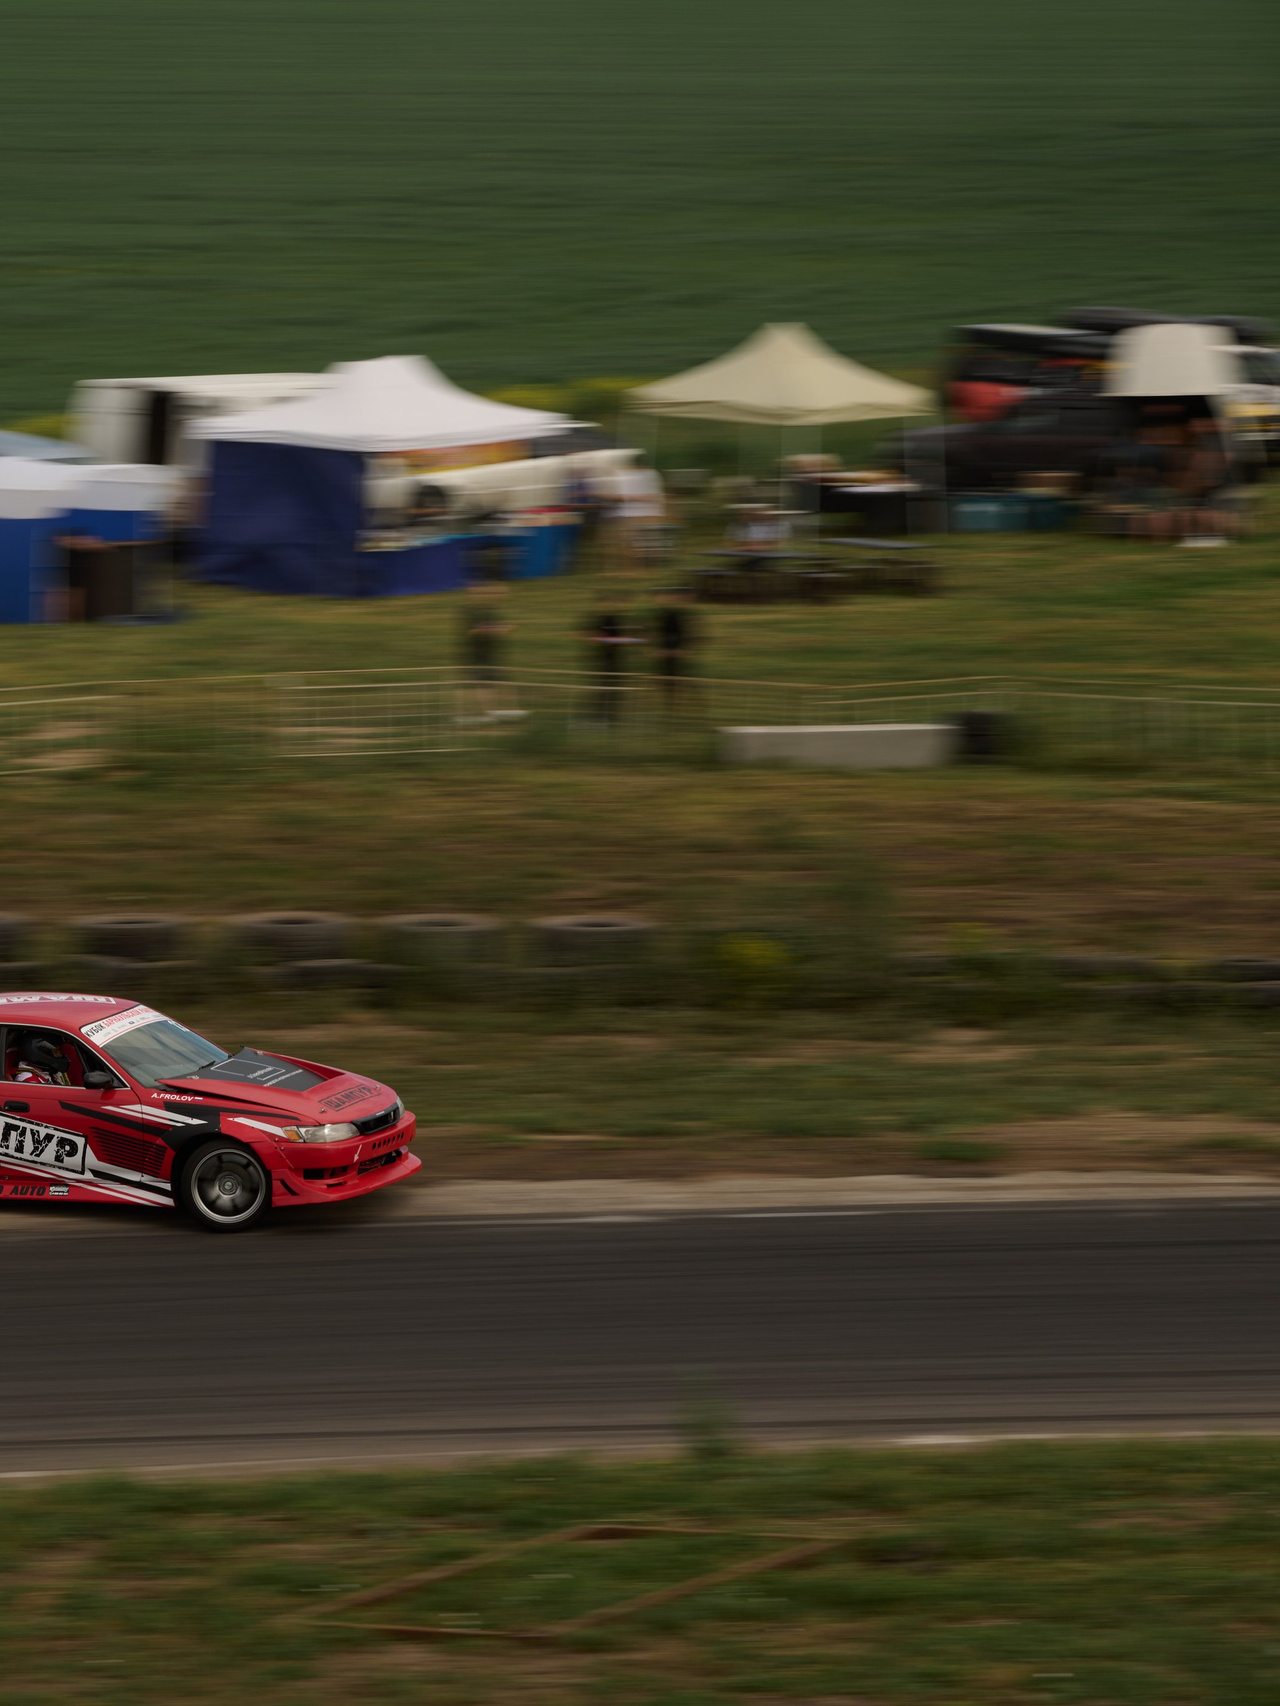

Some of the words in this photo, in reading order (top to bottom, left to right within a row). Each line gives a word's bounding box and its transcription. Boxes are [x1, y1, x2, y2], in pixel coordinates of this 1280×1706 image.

[84, 1023, 106, 1038] КУБОК
[151, 1092, 194, 1102] A.FROLOV
[323, 1086, 373, 1108] ШАМПУР
